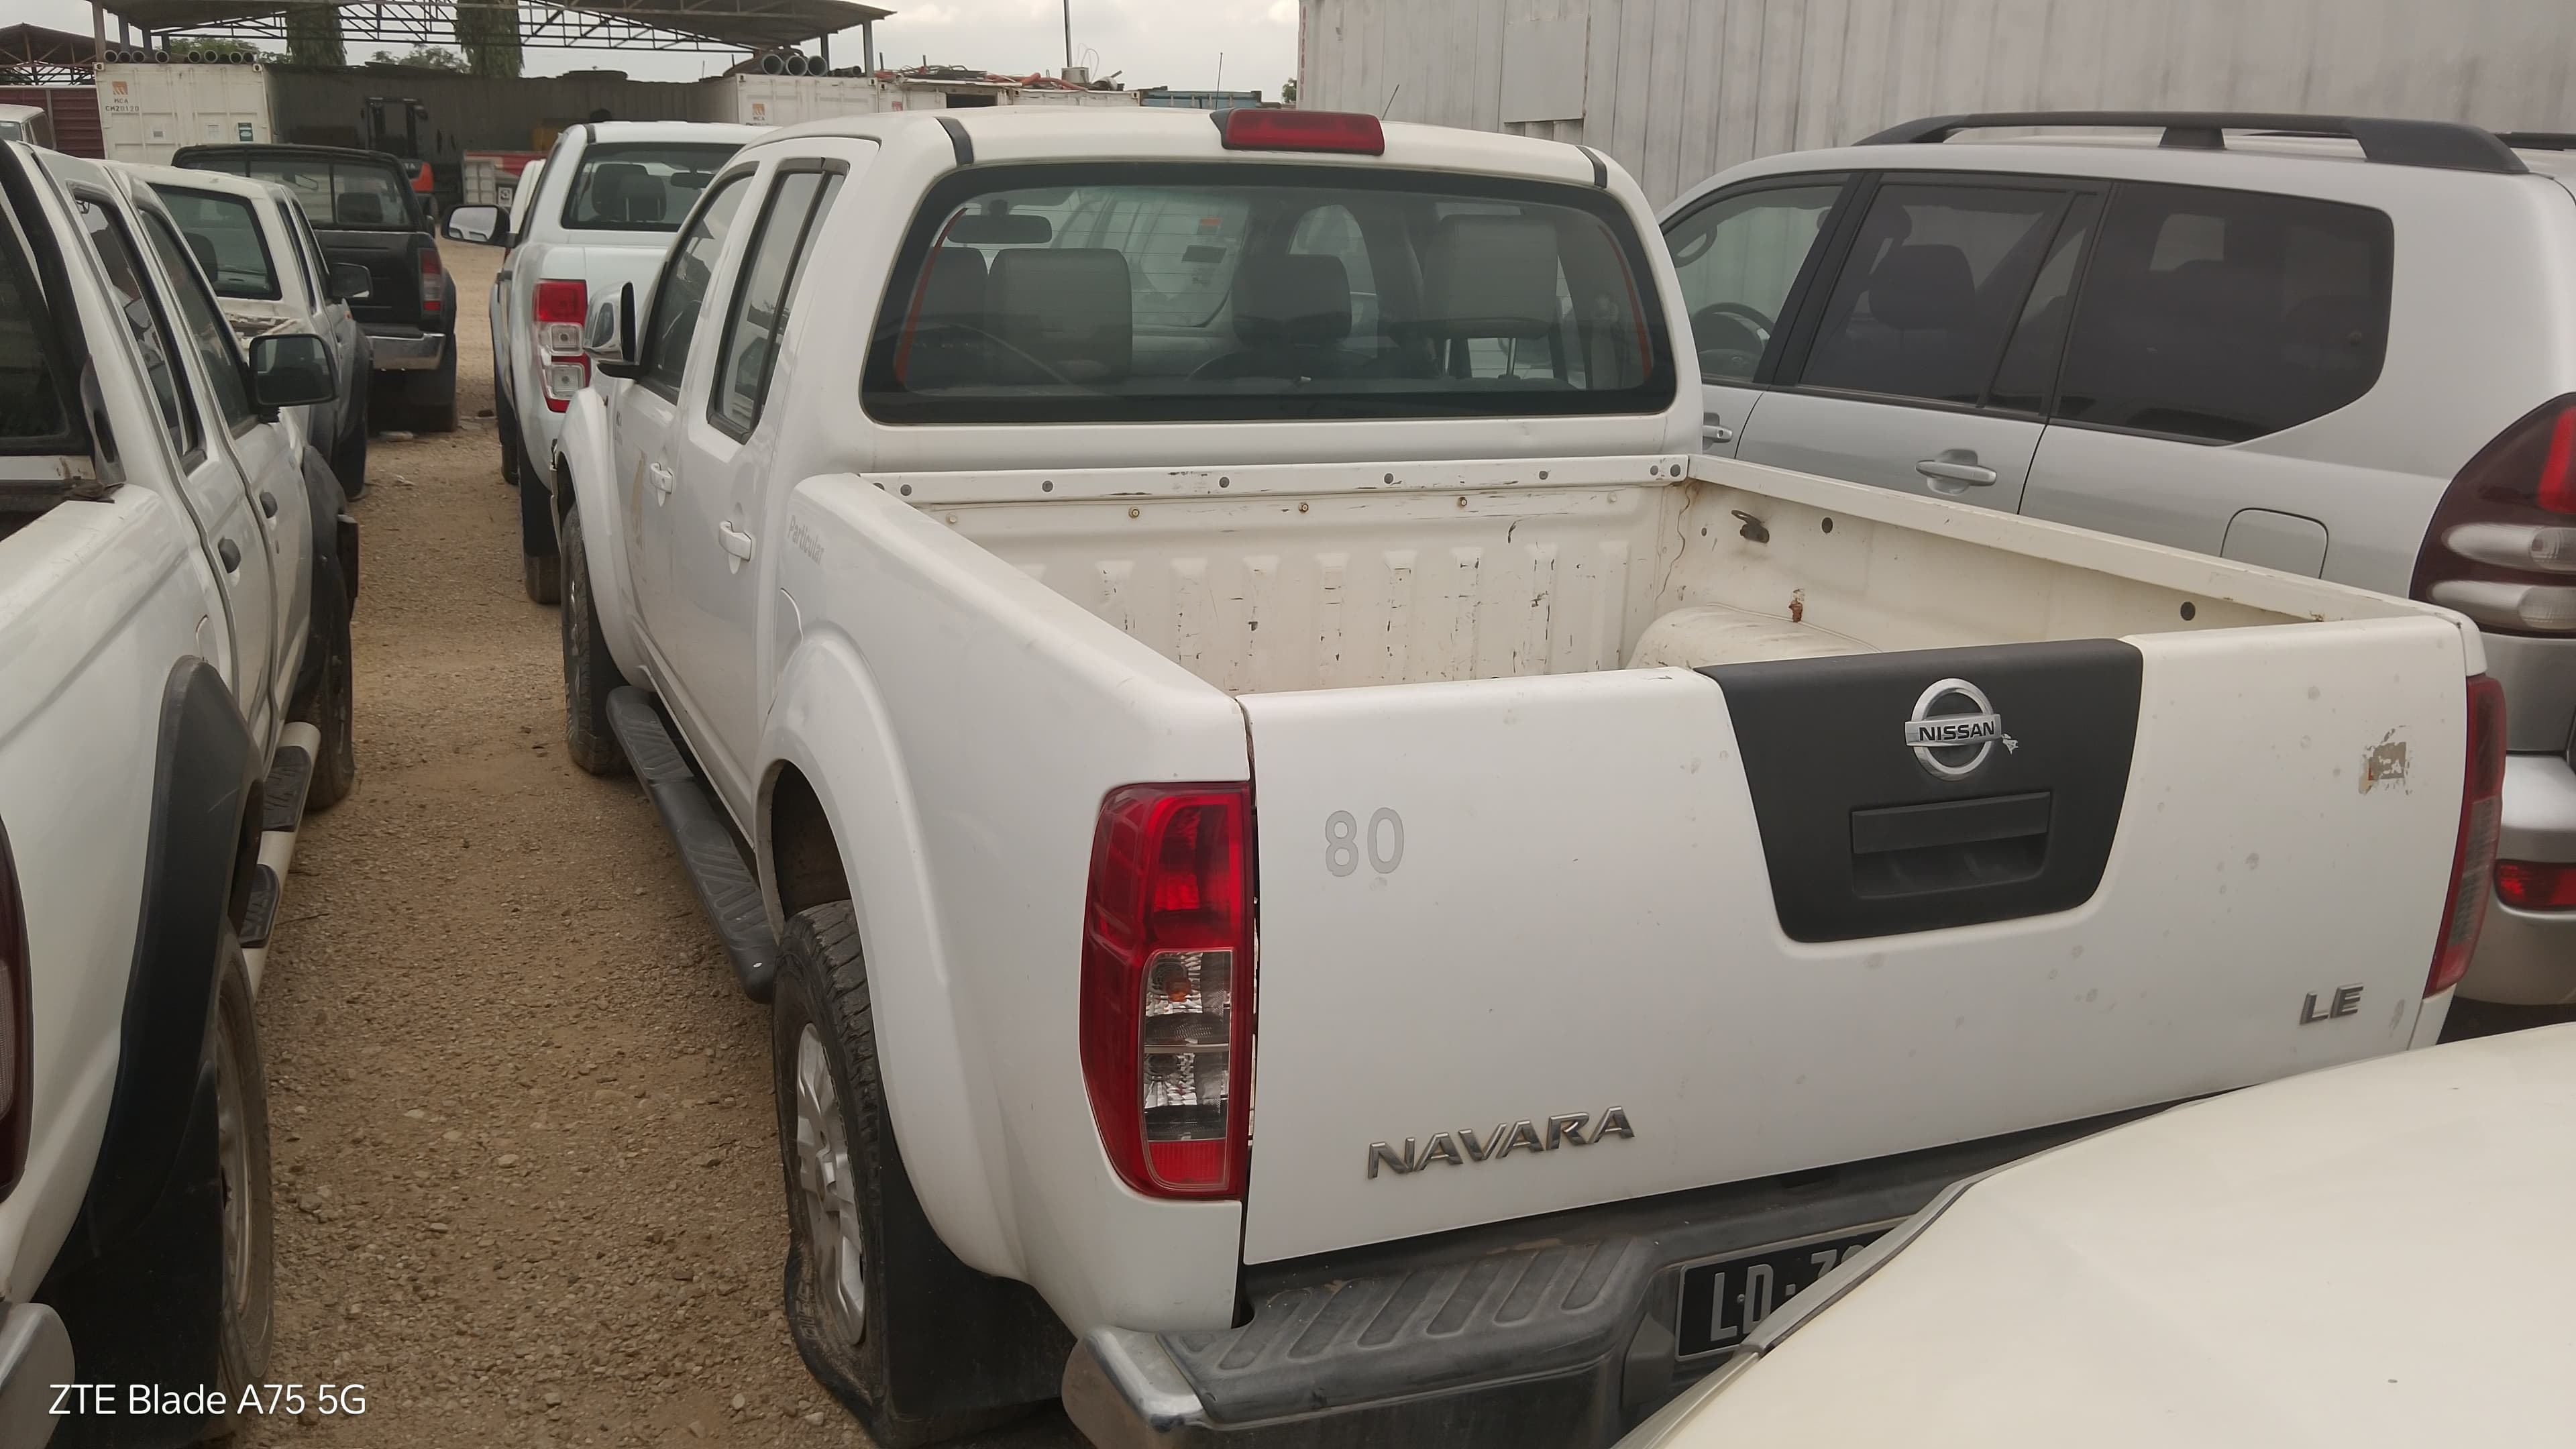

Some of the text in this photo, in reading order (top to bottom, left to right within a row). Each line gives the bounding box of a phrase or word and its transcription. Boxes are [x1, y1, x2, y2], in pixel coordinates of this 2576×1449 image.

[788, 515, 825, 565] Particular
[1919, 720, 1994, 741] NISSAN
[1325, 807, 1404, 877] 80
[2299, 982, 2364, 1026] LE
[1367, 1106, 1635, 1179] NAVARA
